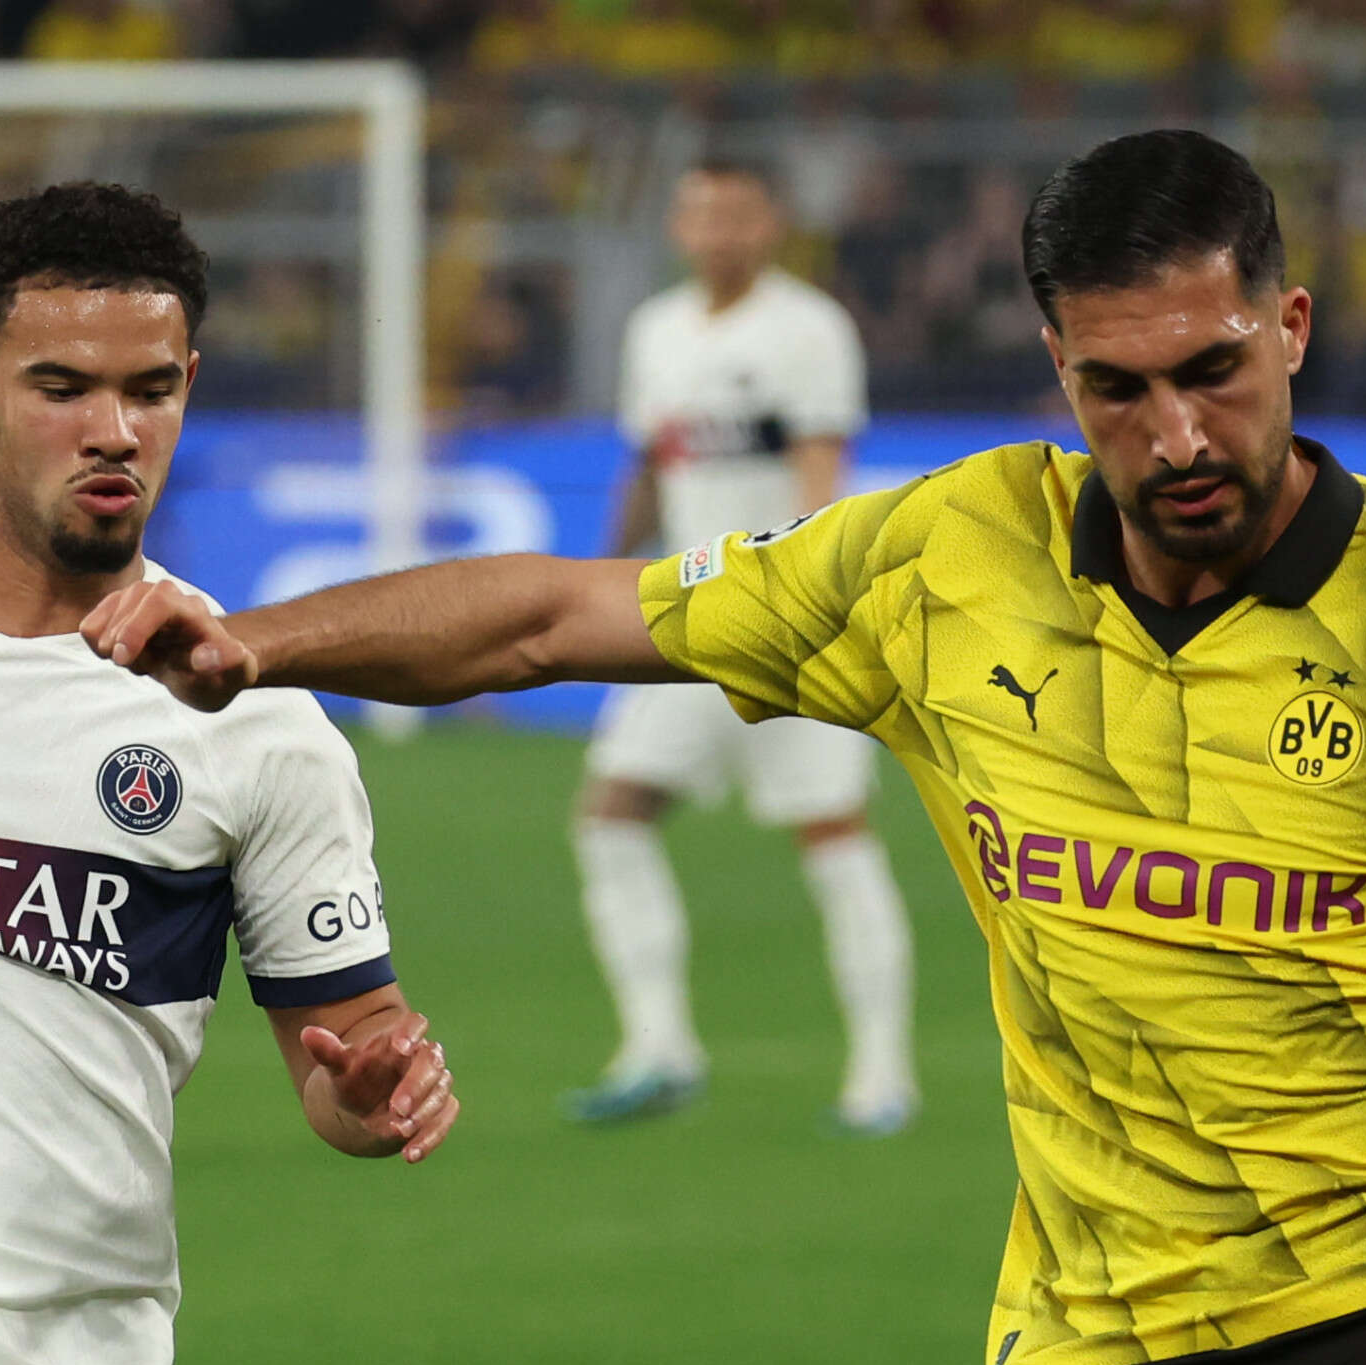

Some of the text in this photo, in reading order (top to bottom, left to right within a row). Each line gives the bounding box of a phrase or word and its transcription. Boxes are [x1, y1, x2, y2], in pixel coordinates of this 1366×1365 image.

[1279, 699, 1354, 760] BVB
[116, 751, 170, 777] PARIS
[1296, 757, 1324, 778] 09
